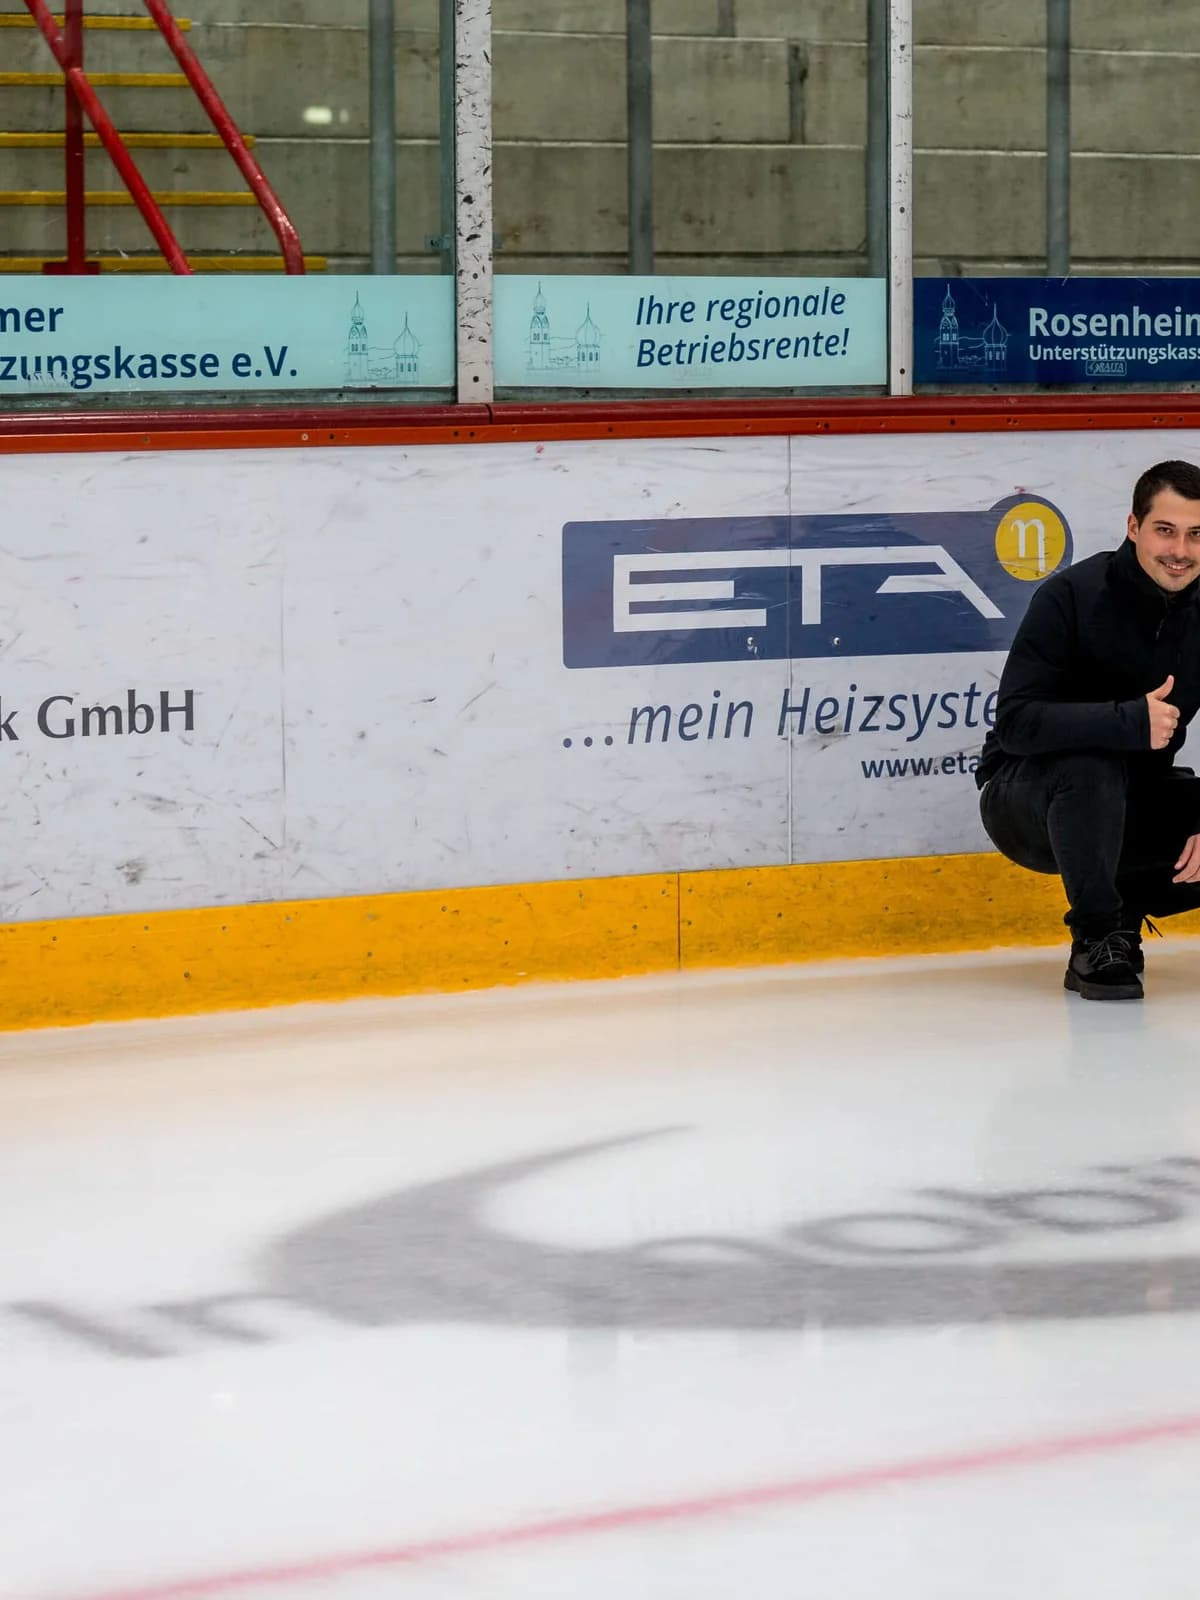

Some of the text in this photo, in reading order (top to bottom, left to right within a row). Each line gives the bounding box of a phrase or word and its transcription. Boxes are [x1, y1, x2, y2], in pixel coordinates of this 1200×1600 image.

[0, 307, 64, 333] mer
[636, 286, 847, 329] Ihre regionale
[0, 345, 298, 389] zungskasse e.V.
[636, 328, 850, 368] Betriebsrente!
[613, 545, 1006, 633] ETA
[37, 689, 195, 739] GmbH
[777, 681, 999, 742] Heizsyste
